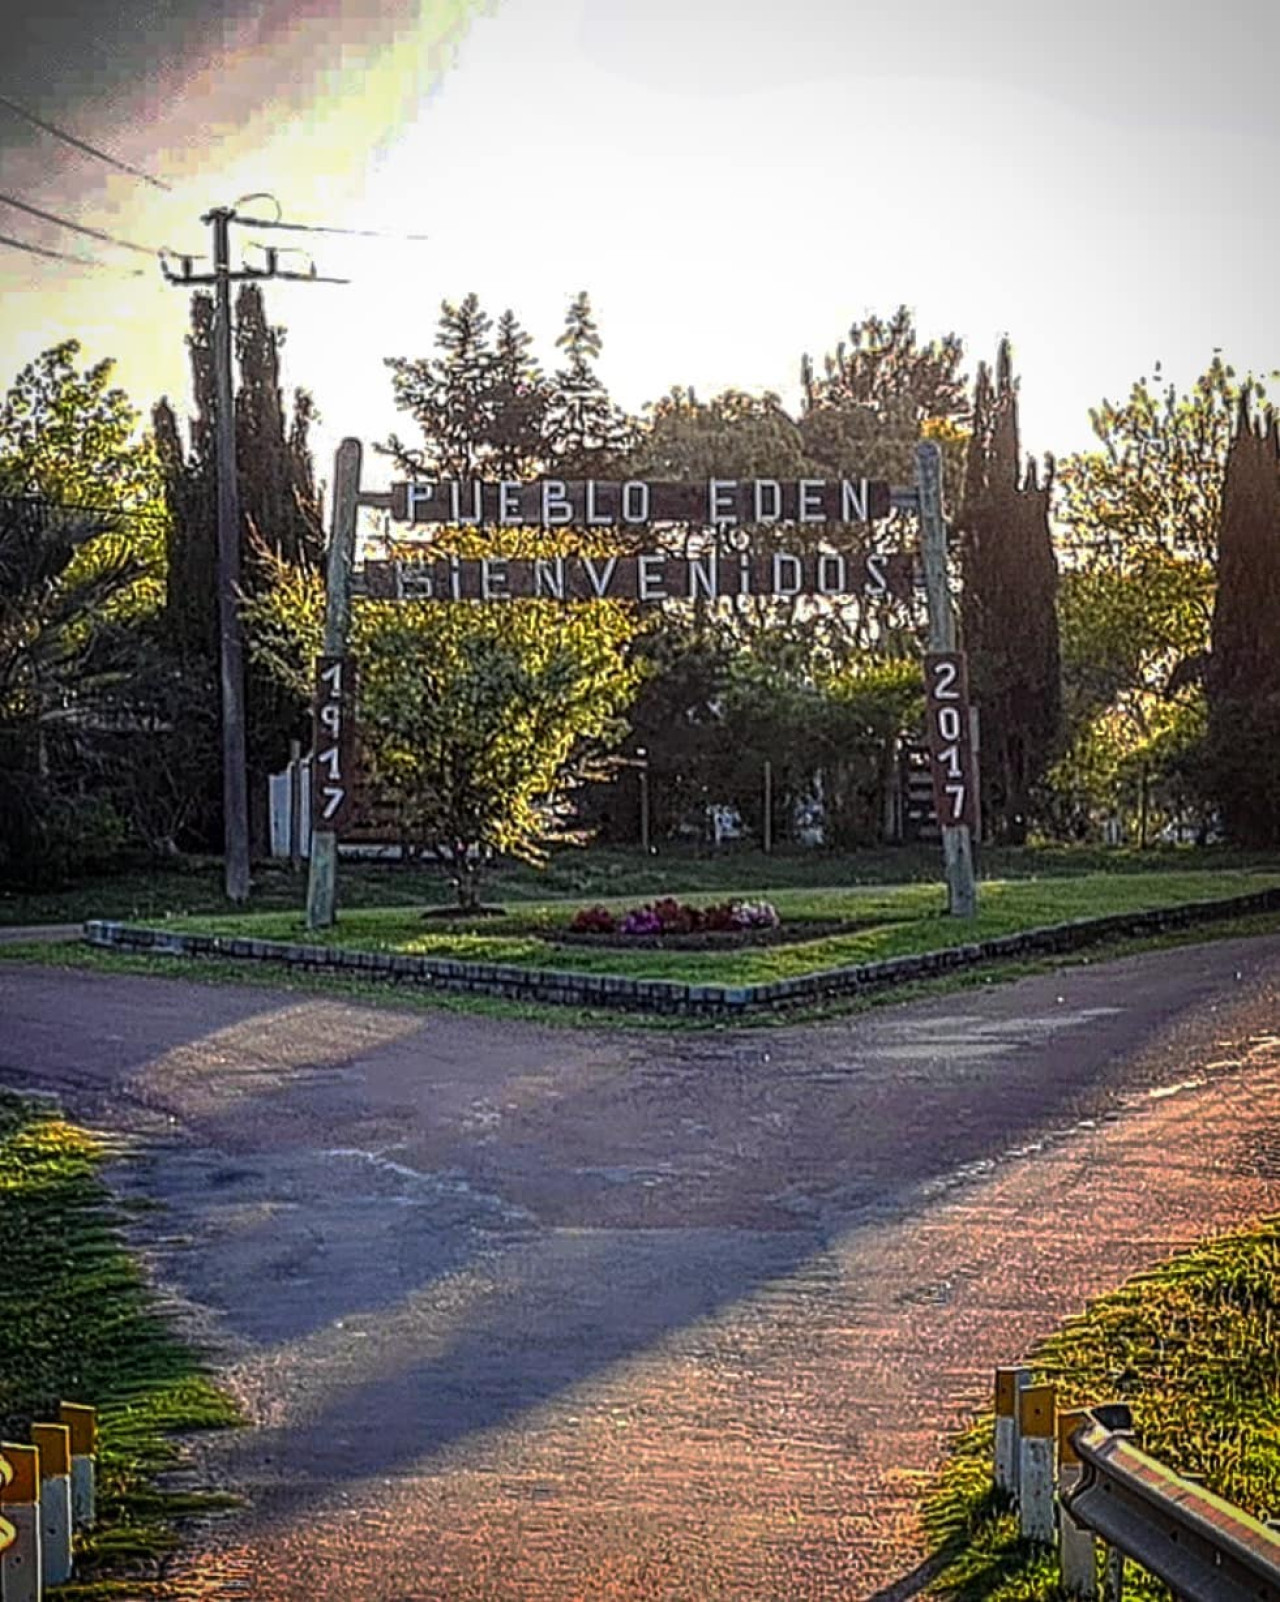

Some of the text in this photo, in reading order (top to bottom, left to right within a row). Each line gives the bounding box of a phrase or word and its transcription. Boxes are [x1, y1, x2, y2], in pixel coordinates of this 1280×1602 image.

[407, 478, 868, 525] PUEBLO EDEN
[318, 663, 345, 819] 1917
[934, 663, 964, 819] 2017
